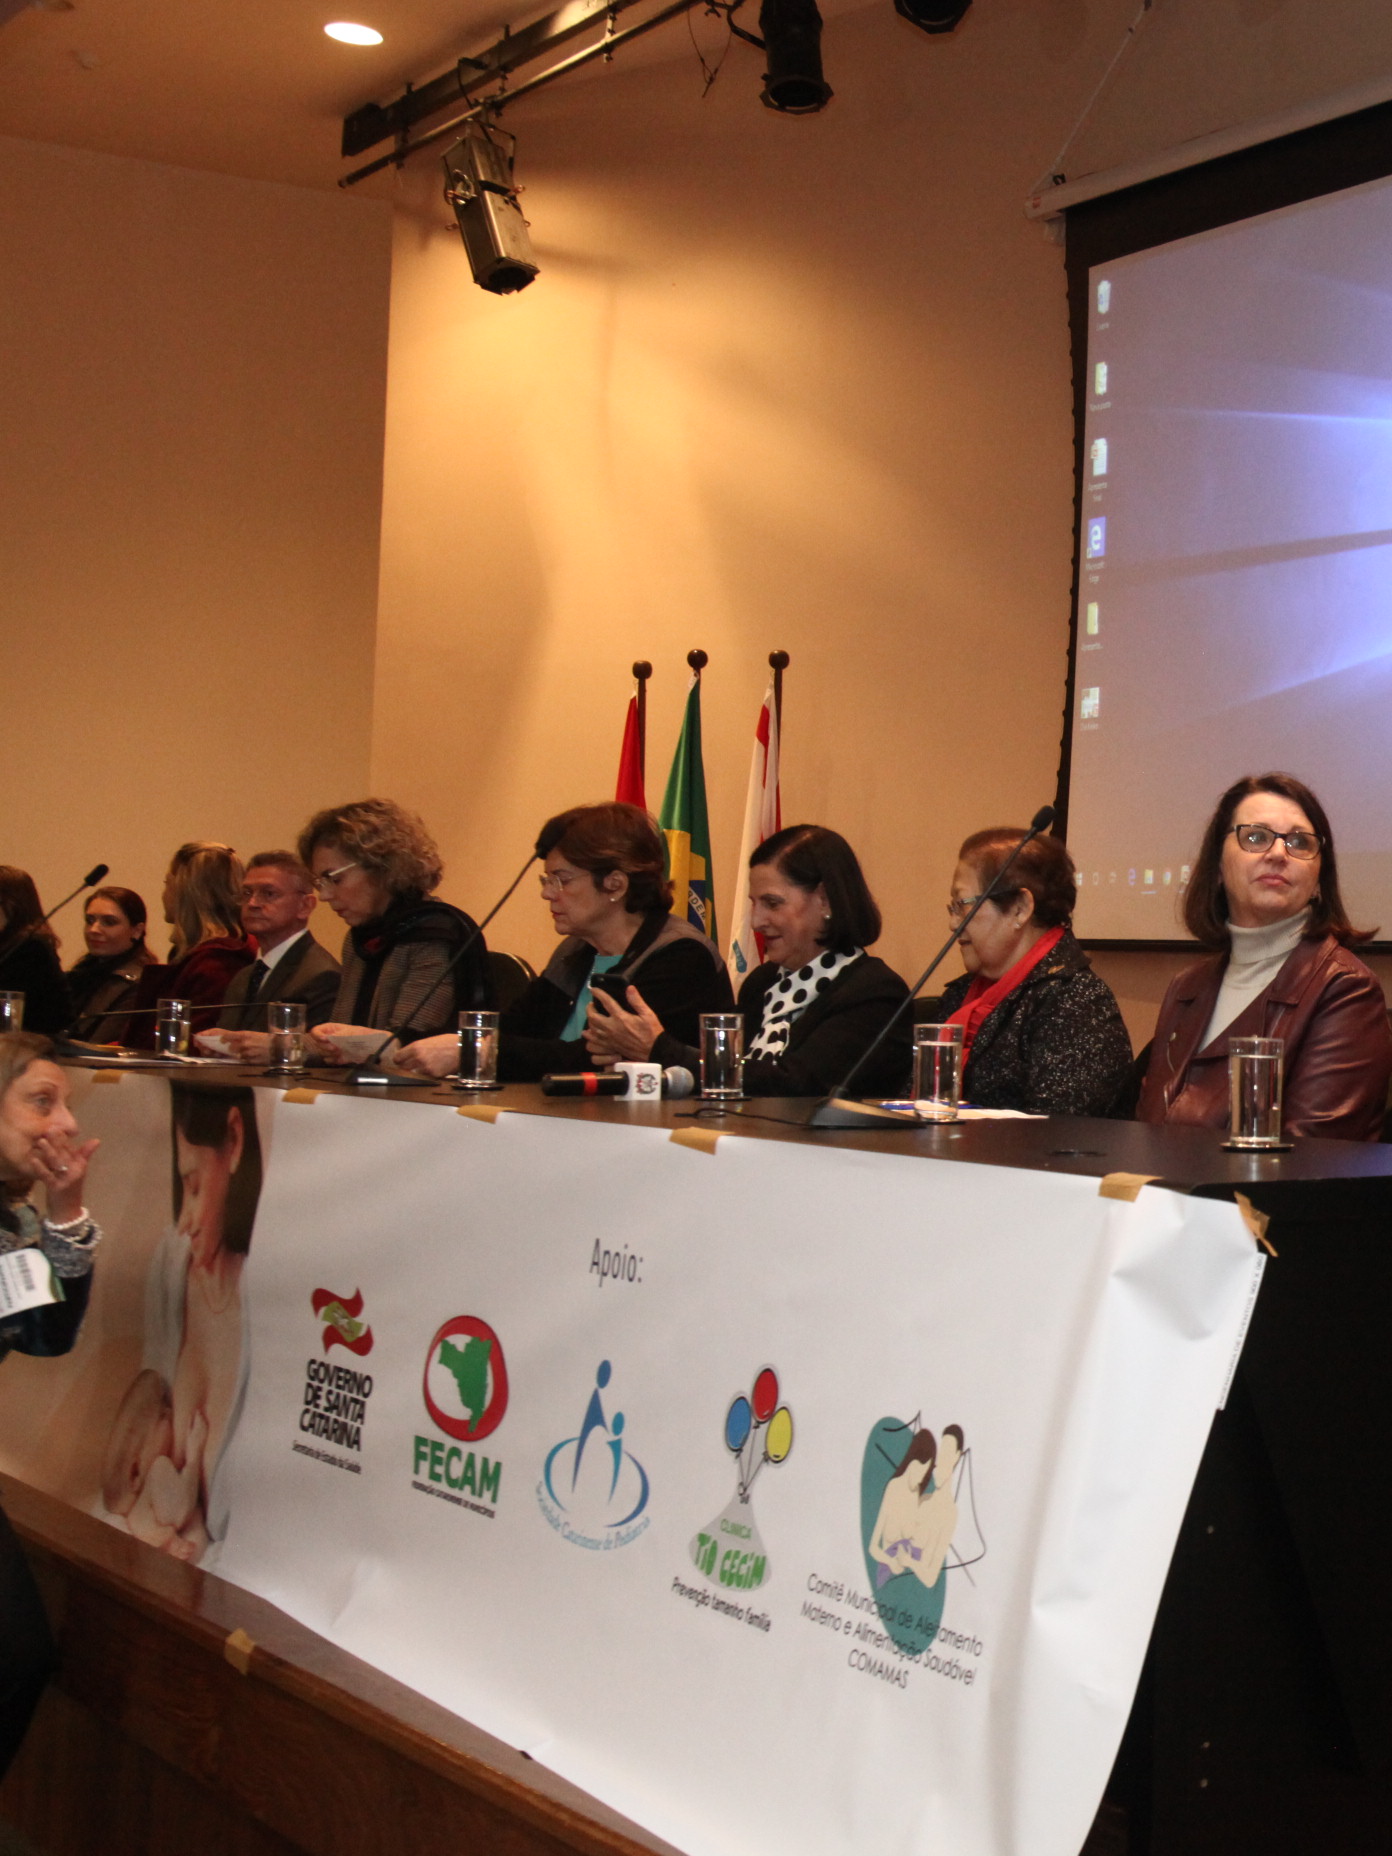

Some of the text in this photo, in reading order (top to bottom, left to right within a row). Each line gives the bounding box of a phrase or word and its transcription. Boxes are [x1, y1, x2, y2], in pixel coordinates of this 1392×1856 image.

[589, 1237, 643, 1287] Apoio:
[307, 1359, 373, 1398] GOVERNO
[304, 1382, 366, 1425] DE SANTA
[300, 1408, 361, 1451] CATARINA
[413, 1435, 502, 1503] FECAM
[672, 1577, 710, 1607] Prevenção
[711, 1593, 744, 1620] tamanho
[807, 1573, 844, 1602] Comitê
[845, 1589, 898, 1621] Municipal
[899, 1608, 913, 1628] de
[800, 1601, 976, 1686] Materno e Alimentação Saudável
[848, 1649, 909, 1688] COMAMAS
